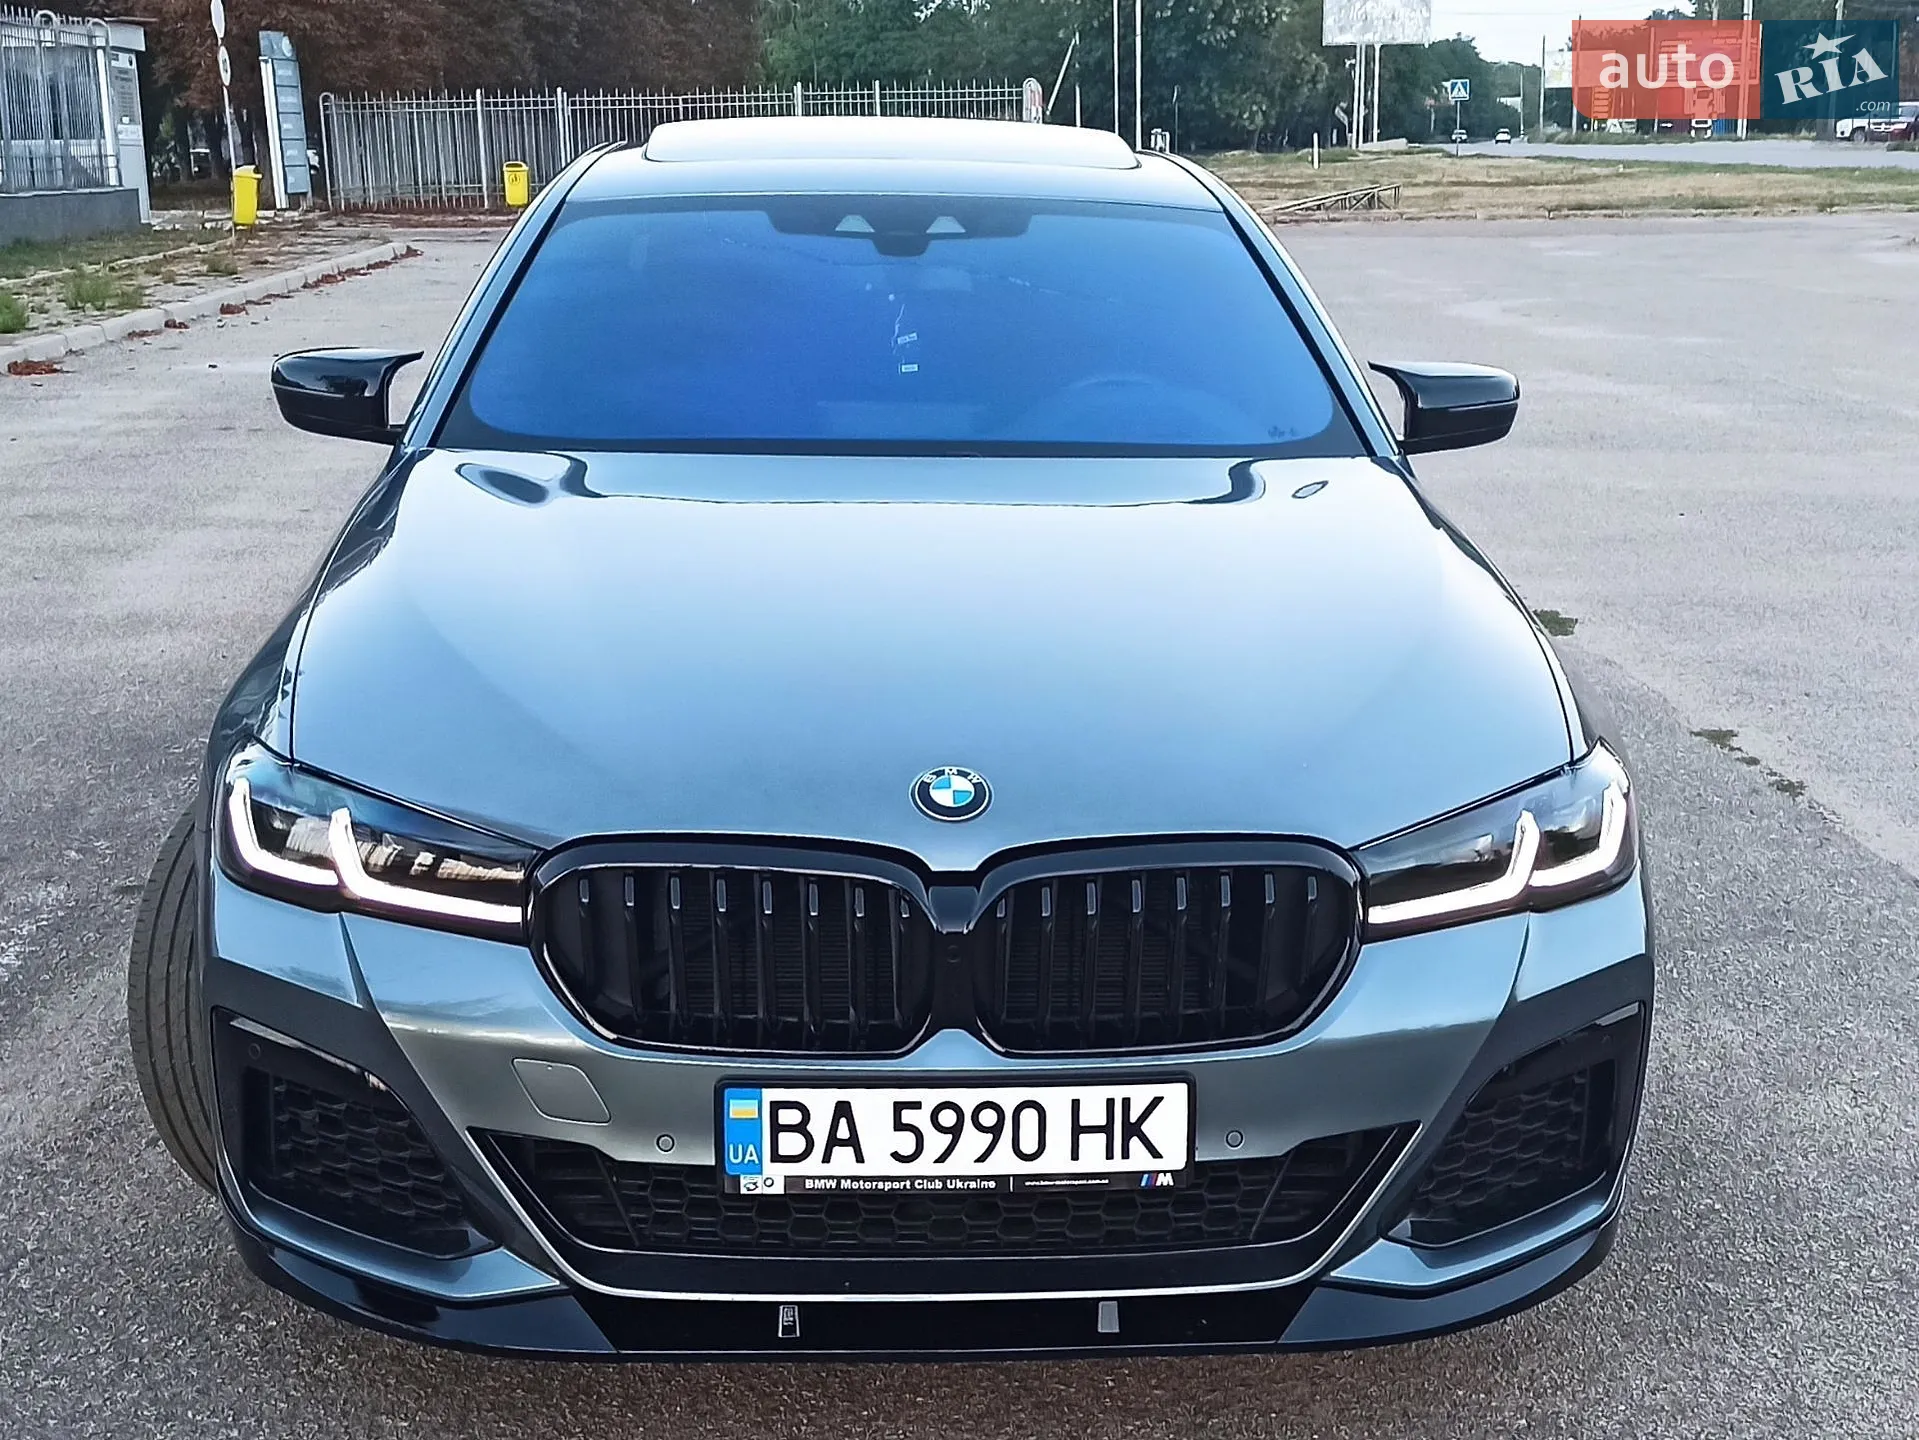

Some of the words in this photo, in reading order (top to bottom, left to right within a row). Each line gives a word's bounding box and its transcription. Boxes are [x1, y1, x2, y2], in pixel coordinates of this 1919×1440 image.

[769, 1100, 865, 1164] BA
[890, 1099, 1047, 1164] 5990
[1070, 1096, 1165, 1161] HK
[729, 1144, 759, 1165] UA
[805, 1179, 837, 1190] BMW
[840, 1179, 911, 1191] Motorsport
[914, 1179, 943, 1190] Club
[946, 1179, 997, 1190] Ukraine
